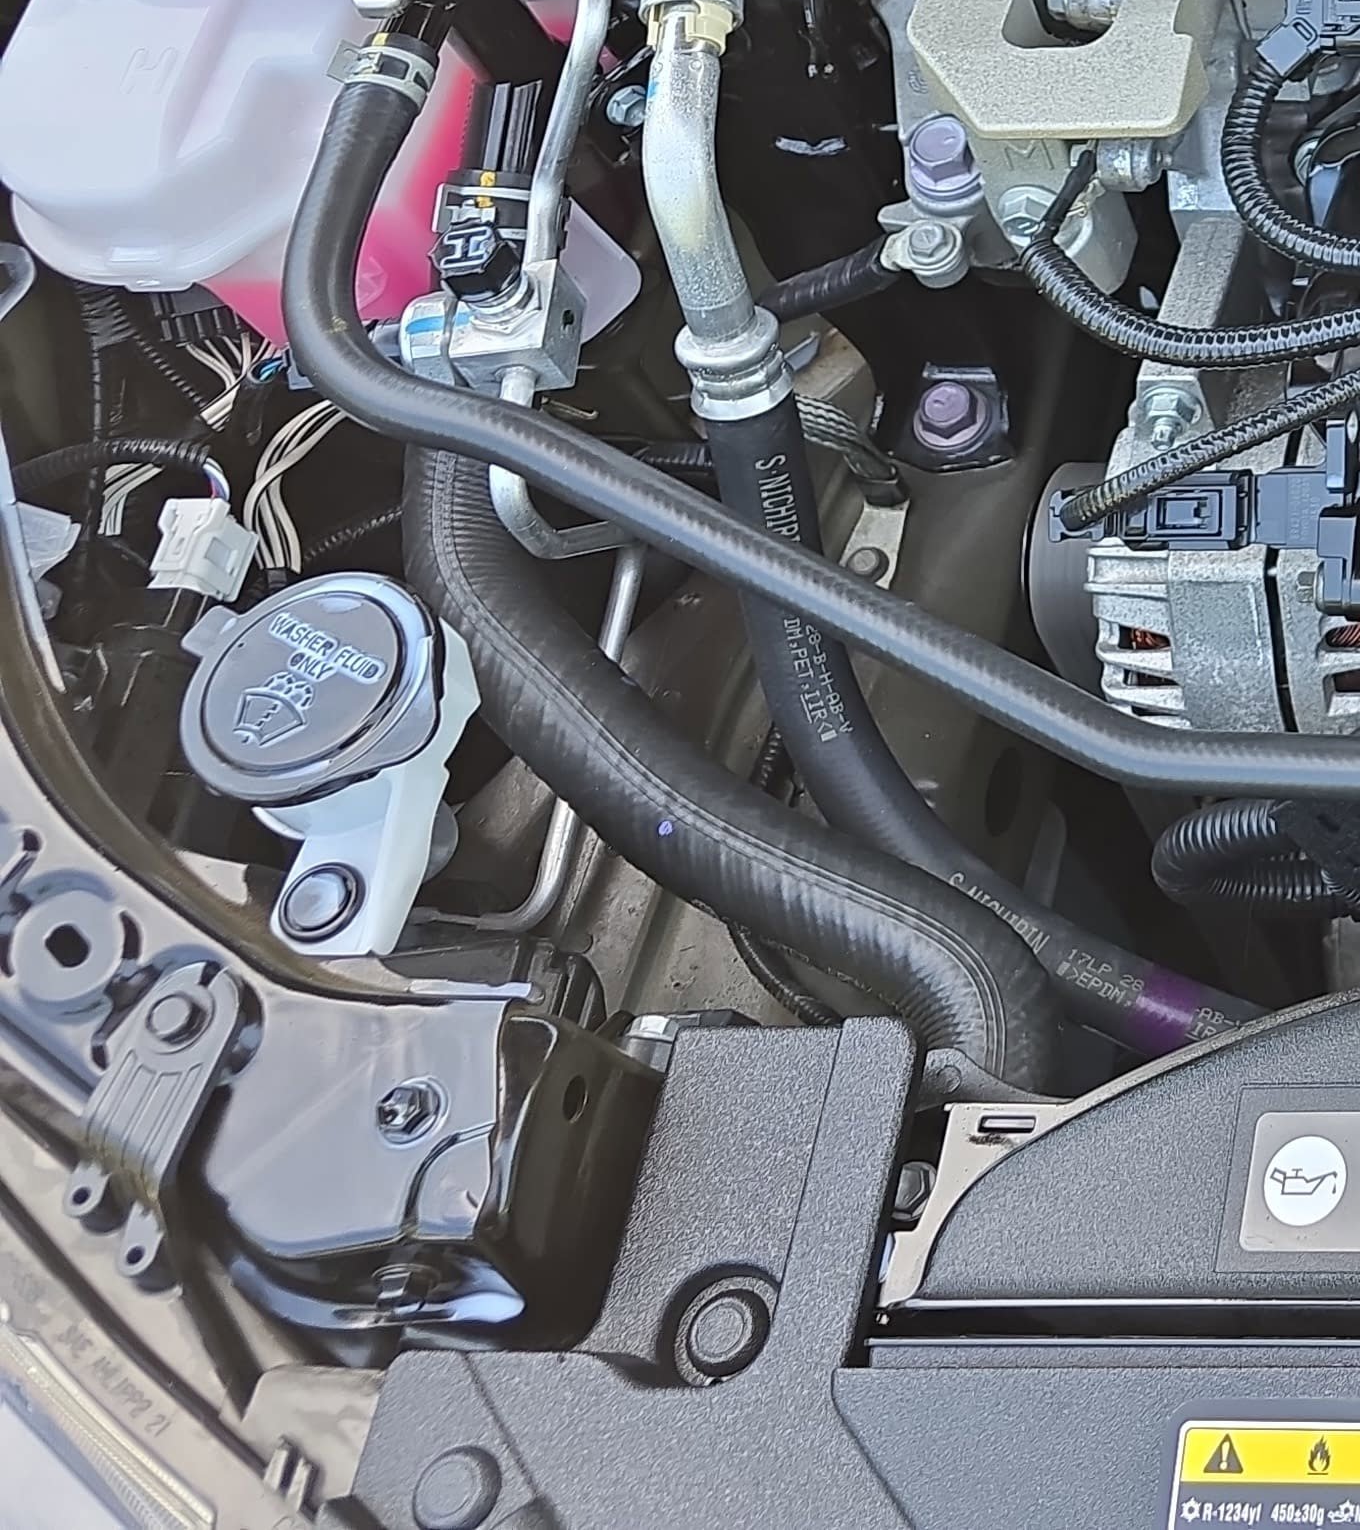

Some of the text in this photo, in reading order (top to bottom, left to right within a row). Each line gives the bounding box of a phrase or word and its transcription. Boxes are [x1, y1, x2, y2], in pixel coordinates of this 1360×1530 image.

[269, 612, 381, 680] WASHER FLUID
[289, 651, 335, 680] ONLY
